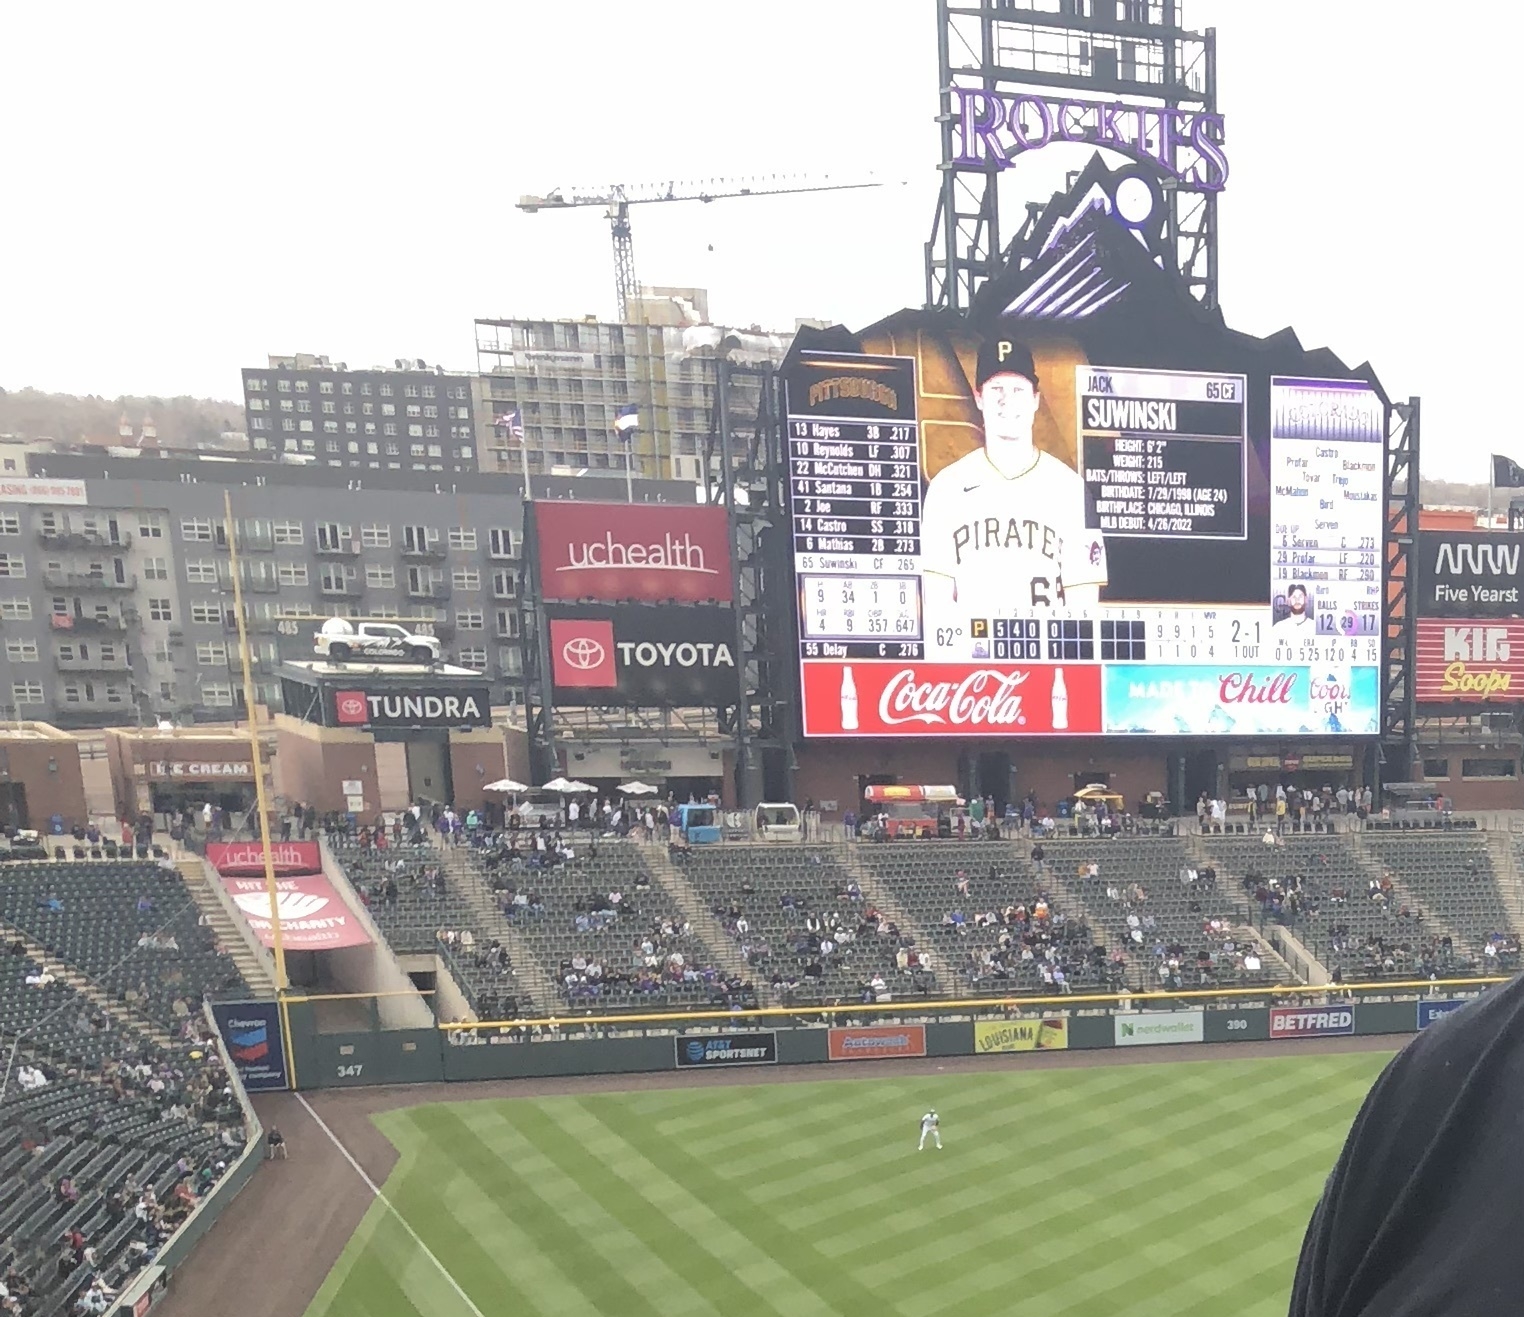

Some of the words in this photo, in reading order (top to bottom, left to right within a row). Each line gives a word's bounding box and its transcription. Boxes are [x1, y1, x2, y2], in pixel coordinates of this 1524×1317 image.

[952, 86, 1229, 192] ROCKIES
[1088, 375, 1114, 394] JACK
[1206, 382, 1219, 399] 65
[1222, 384, 1234, 399] CF
[1087, 398, 1177, 431] SUWINSKI
[795, 423, 808, 436] 13
[812, 424, 840, 440] Hayes
[866, 426, 880, 440] 3B
[889, 427, 910, 441] .217
[796, 442, 809, 456] 10
[813, 443, 854, 459] Reynolds
[868, 445, 880, 459] LF
[890, 446, 910, 460] .307
[1115, 439, 1144, 453] HEIGHT:
[1113, 454, 1145, 468] WEIGHT:
[1147, 456, 1163, 469] 215
[796, 462, 810, 475] 22
[814, 462, 864, 477] McCutchen
[868, 464, 882, 478] DH
[891, 466, 911, 478] .321
[1086, 469, 1145, 484] BATS/THROWS:
[1148, 471, 1187, 485] LEFT/LEFT
[798, 481, 810, 494] 41
[814, 480, 852, 496] Santana
[870, 483, 882, 496] 1B
[892, 484, 912, 497] .254
[1101, 486, 1145, 499] BIRTHDATE:
[1193, 489, 1212, 503] (AGE
[1214, 489, 1228, 504] 24)
[804, 500, 812, 512] 2
[816, 501, 832, 514] Joe
[870, 502, 882, 515] RF
[892, 502, 914, 516] .333
[1096, 500, 1145, 515] BIRTHPLACE:
[1148, 502, 1183, 516] CHICAGO,
[1184, 504, 1215, 517] ILLINOIS
[800, 518, 812, 532] 14
[816, 519, 847, 533] Castro
[870, 520, 884, 534] SS
[893, 520, 914, 534] .318
[1100, 516, 1118, 529] MLB
[1118, 516, 1146, 530] DEBUT:
[1148, 518, 1192, 532] 4/26/2022
[568, 531, 705, 569] uchealth
[806, 538, 814, 550] 6
[818, 538, 854, 552] Mathias
[872, 539, 885, 552] 2B
[894, 540, 914, 553] .273
[802, 556, 814, 570] 65
[874, 558, 884, 570] CF
[842, 590, 855, 604] 34
[1435, 584, 1468, 602] Five
[1317, 600, 1338, 610] BALLS
[1354, 601, 1379, 611] STRIKES
[996, 624, 1004, 636] 5
[1012, 624, 1020, 636] 4
[1029, 624, 1036, 636] 0
[1051, 624, 1058, 637] 0
[1320, 614, 1334, 631] 12
[1340, 616, 1354, 629] 29
[1362, 614, 1376, 631] 17
[617, 642, 735, 668] TOYOTA
[806, 642, 818, 656] 55
[822, 643, 848, 658] Delay
[878, 644, 886, 656] C
[898, 644, 918, 657] .276
[998, 644, 1005, 656] 0
[1014, 644, 1021, 656] 0
[1030, 644, 1036, 656] 0
[1052, 644, 1058, 657] 1
[1242, 646, 1260, 659] OUT
[1218, 671, 1298, 704] Chill
[878, 668, 1031, 725] Coca-Cola
[366, 695, 481, 719] TUNDRA
[188, 763, 248, 775] CREAM
[228, 1019, 268, 1028] Chevron
[1136, 1022, 1195, 1036] nerdwallet
[1226, 1019, 1248, 1030] 390
[1273, 1012, 1352, 1032] BETFRED
[706, 1039, 732, 1050] AT&T
[979, 1026, 1034, 1051] LOUISIANA
[705, 1047, 768, 1060] SPORTSNET
[338, 1064, 364, 1078] 347
